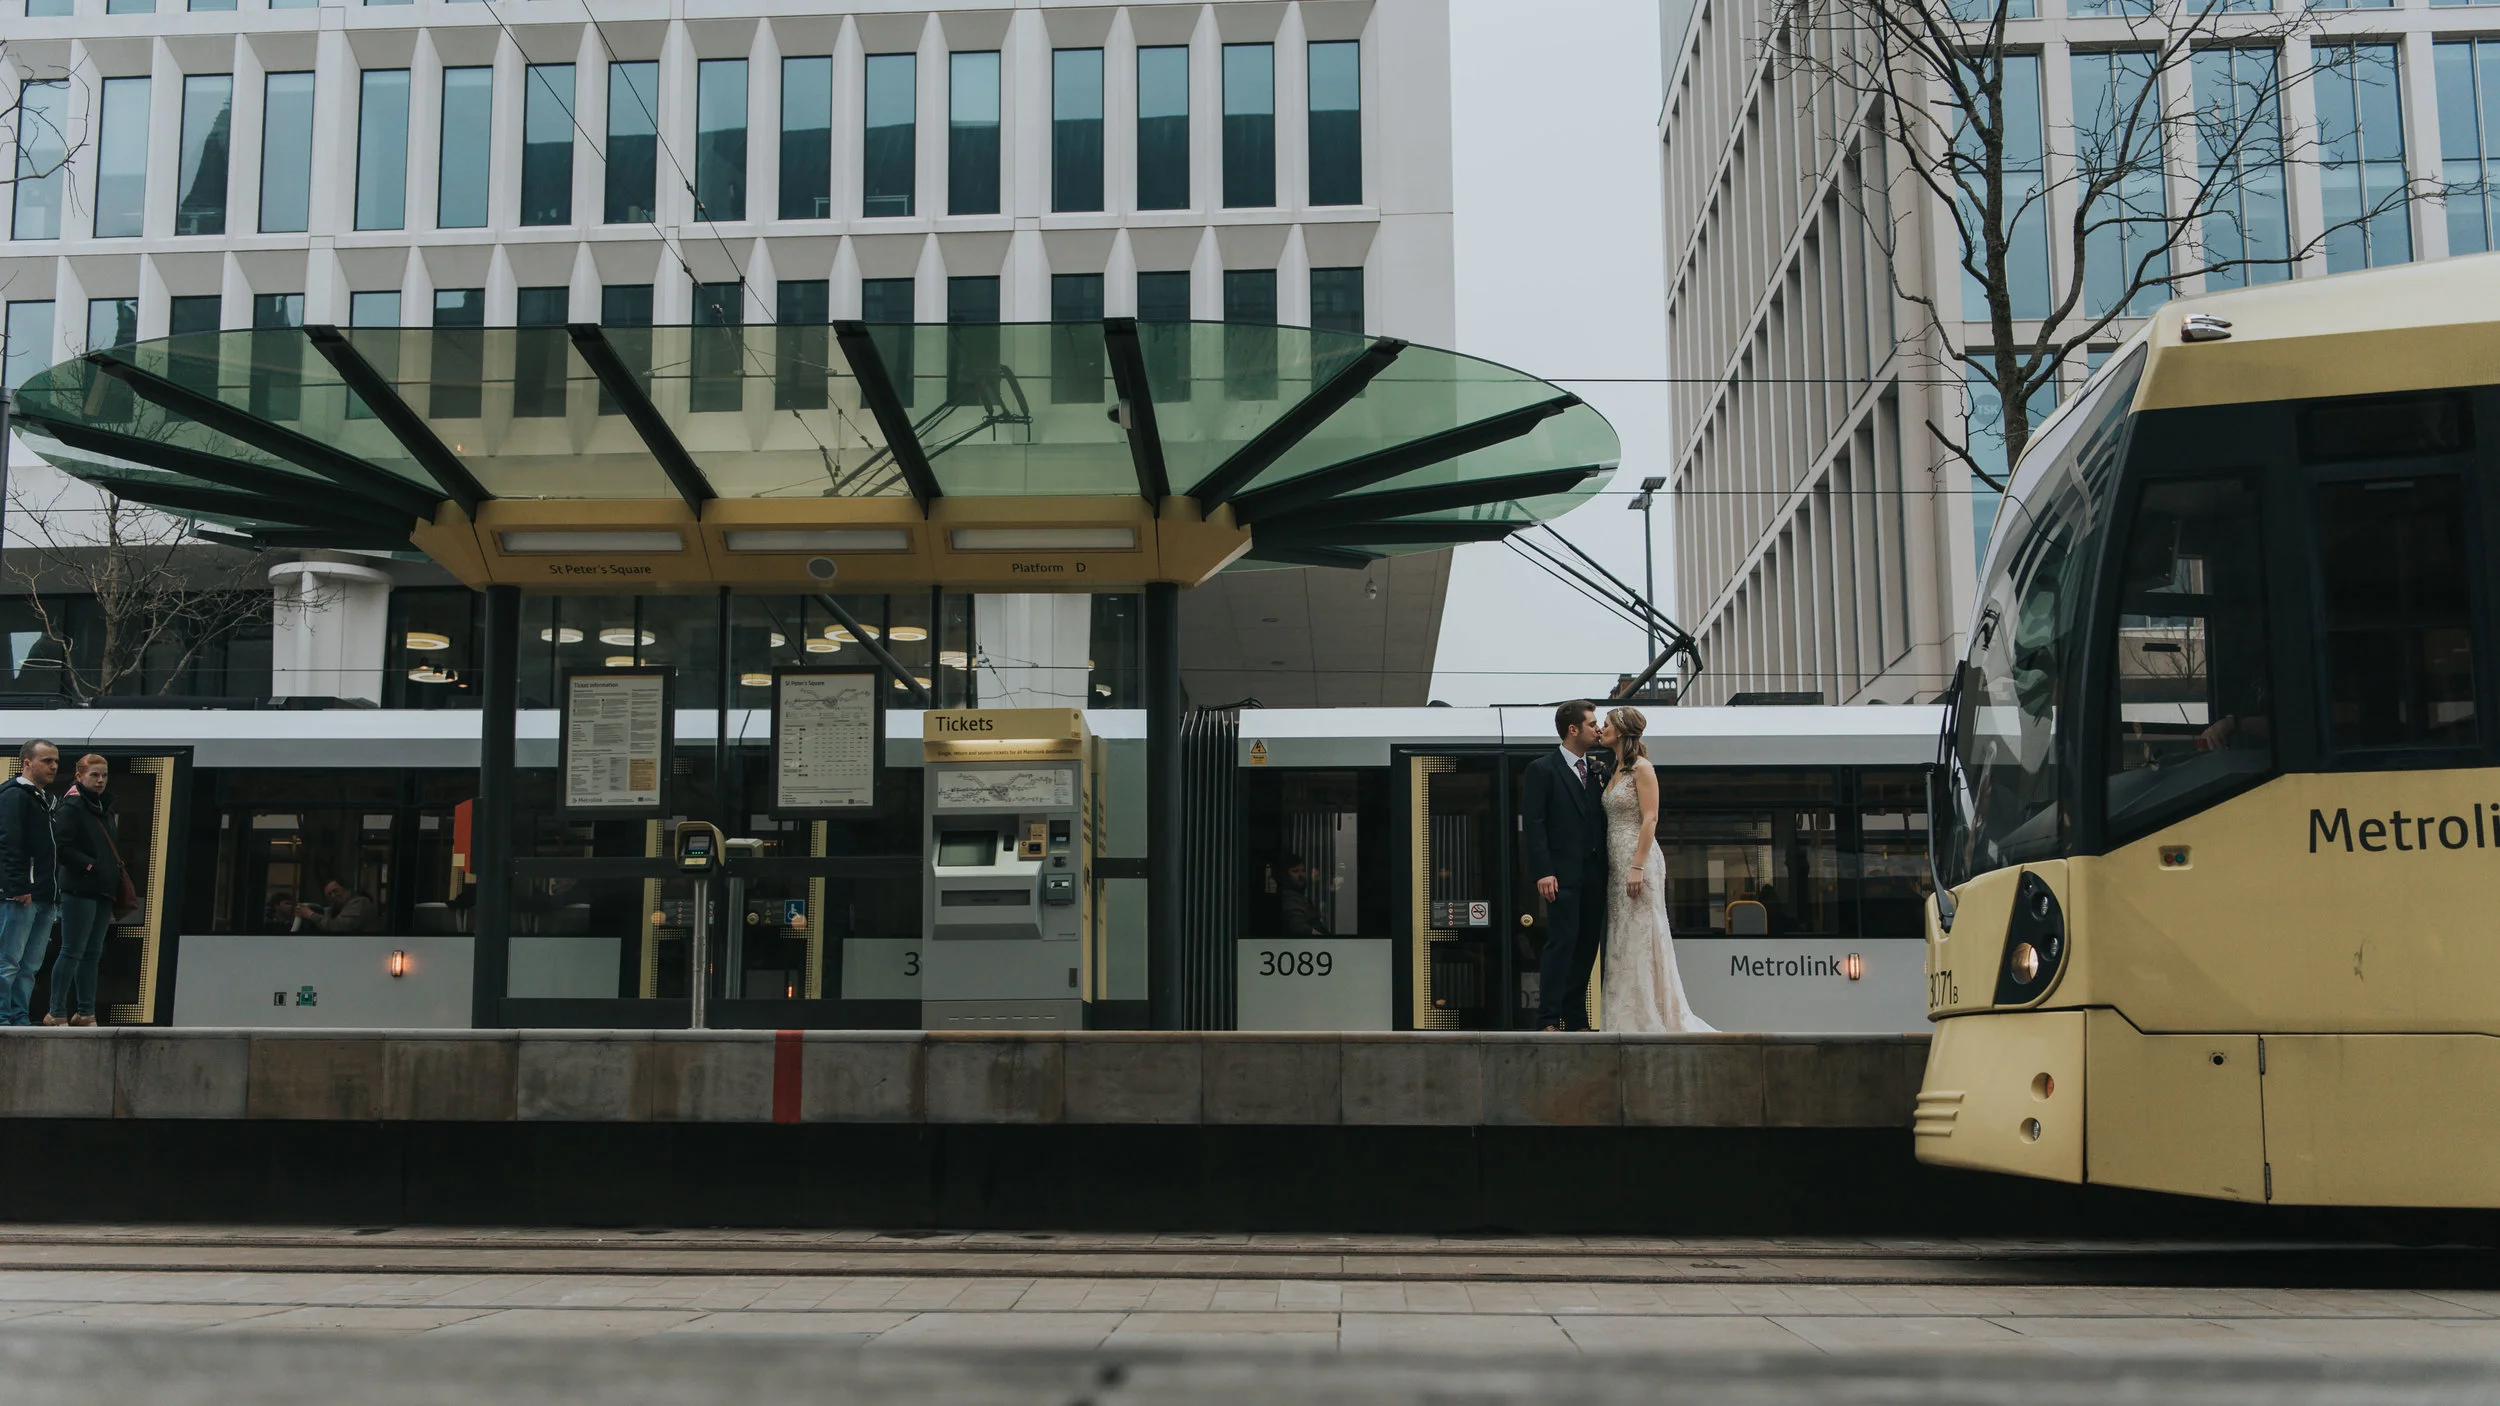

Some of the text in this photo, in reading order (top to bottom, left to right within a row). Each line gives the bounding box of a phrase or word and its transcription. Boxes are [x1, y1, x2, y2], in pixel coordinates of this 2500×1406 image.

[549, 564, 653, 577] St Peter's Square
[1012, 562, 1087, 573] Platform D
[935, 716, 993, 732] Tickets
[2309, 802, 2500, 854] Metroli
[1259, 950, 1333, 977] 3089
[1730, 955, 1842, 977] Metrolink
